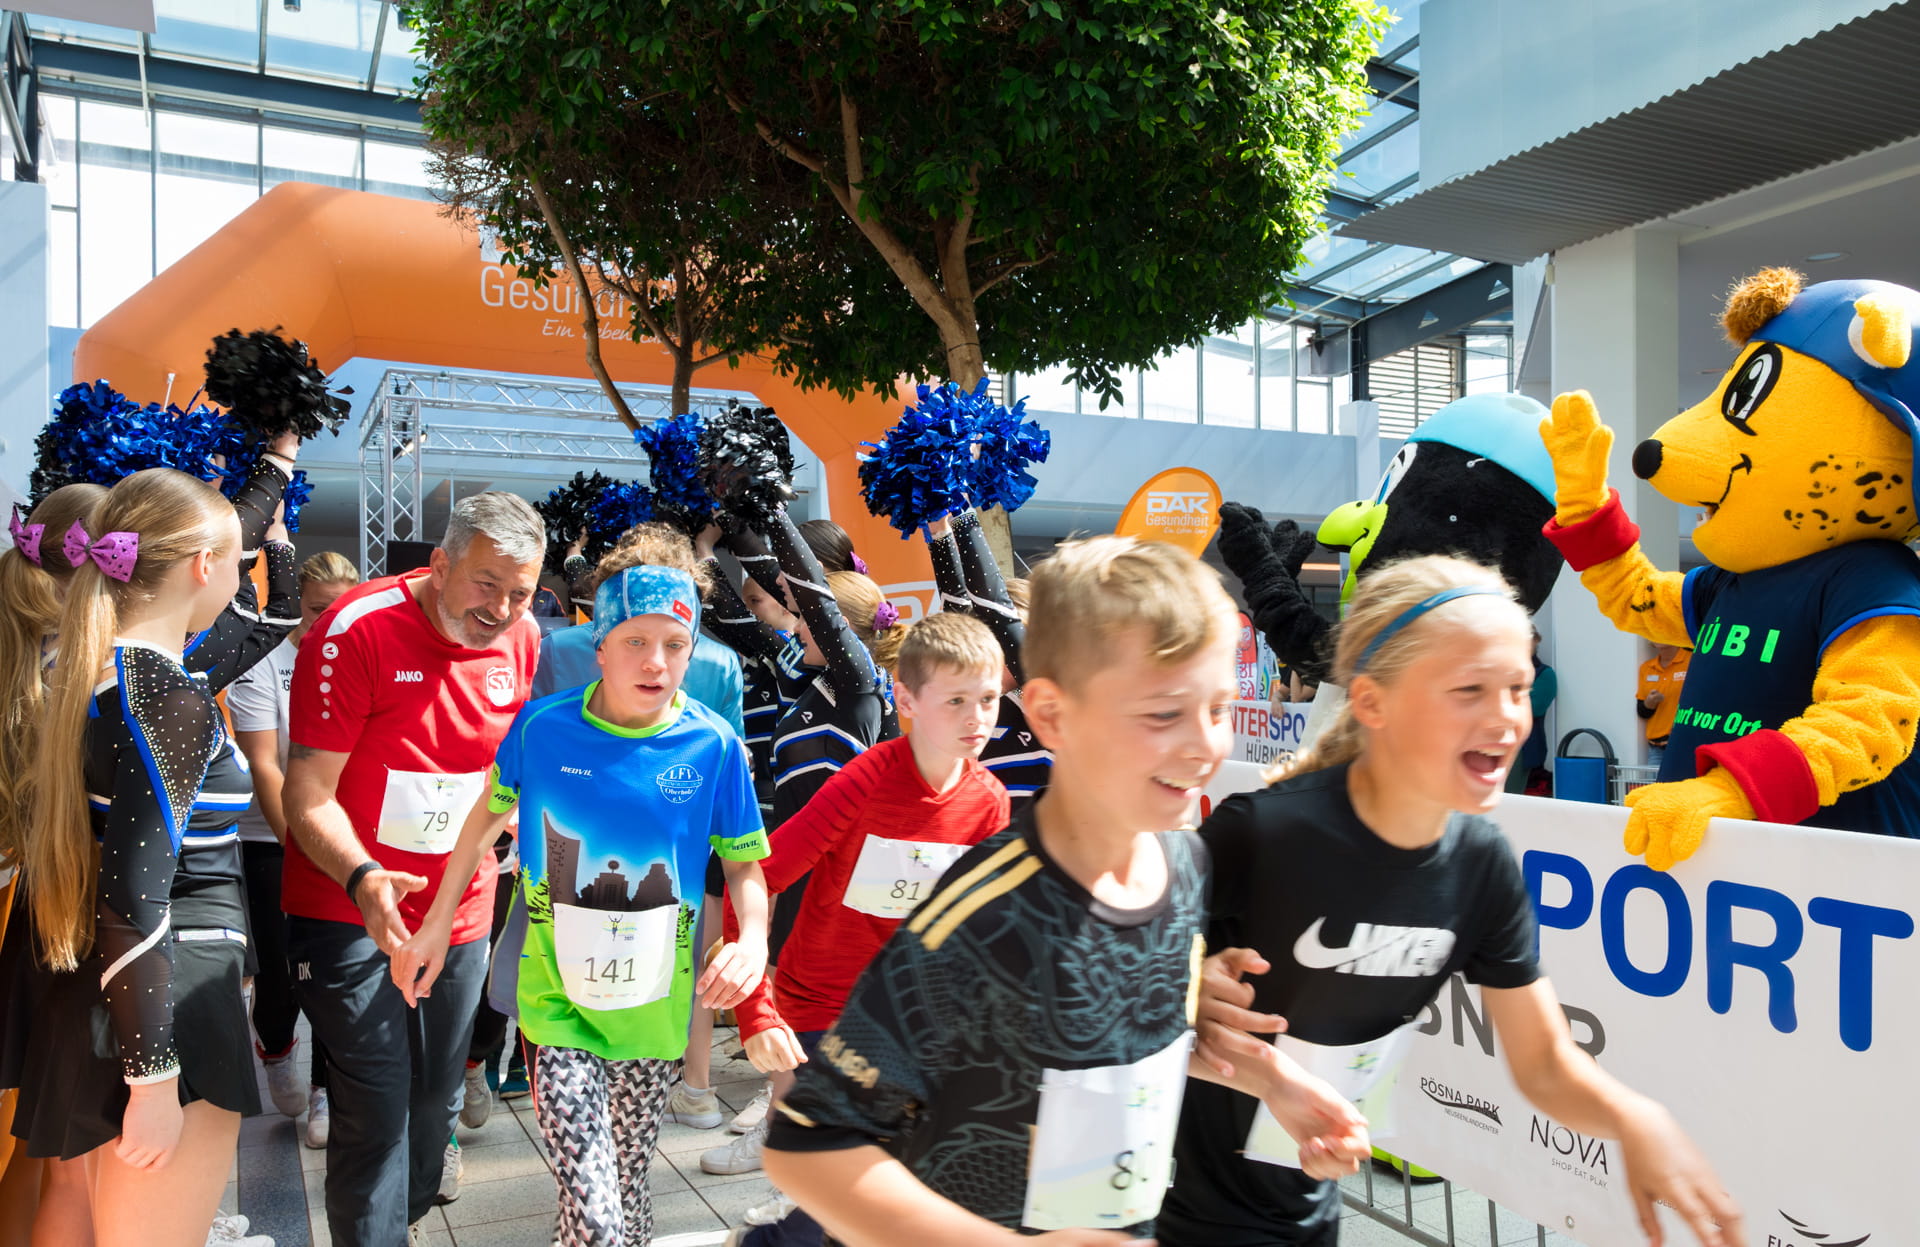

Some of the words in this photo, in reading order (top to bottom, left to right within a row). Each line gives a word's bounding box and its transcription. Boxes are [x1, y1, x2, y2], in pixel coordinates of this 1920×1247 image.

[542, 319, 575, 338] Ein
[1147, 492, 1209, 514] DAK
[1146, 513, 1209, 527] Gesundheit
[394, 670, 424, 682] JAKO
[1693, 711, 1722, 730] vor
[1723, 712, 1762, 736] Ort
[560, 765, 593, 777] REDVIL
[423, 811, 450, 832] 79
[890, 879, 921, 901] 81
[298, 961, 312, 980] DK
[584, 956, 637, 984] 141
[1421, 1077, 1462, 1105] PÖSNA
[1466, 1095, 1500, 1116] PARK
[1530, 1114, 1609, 1175] NOVA
